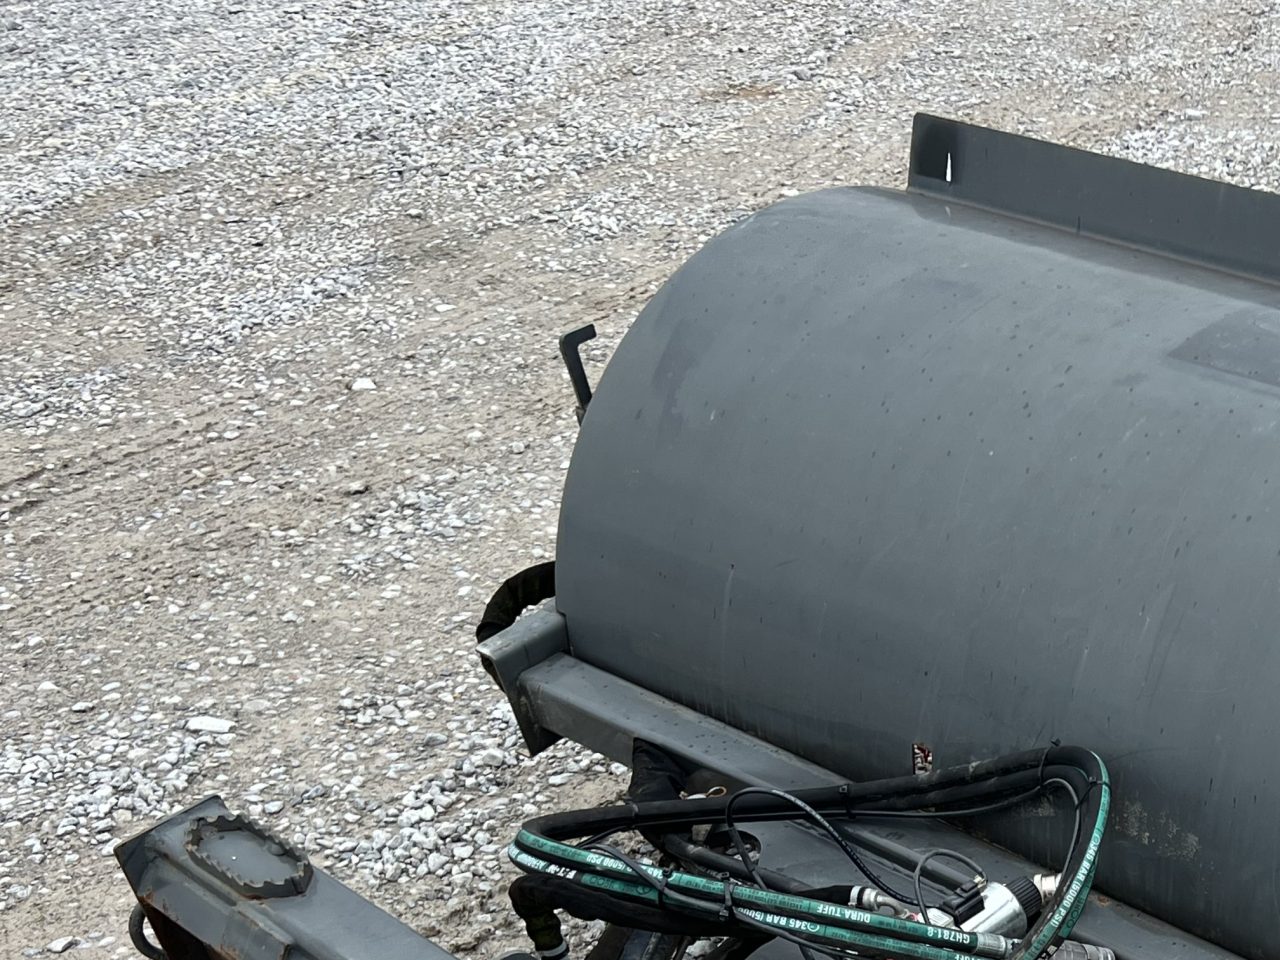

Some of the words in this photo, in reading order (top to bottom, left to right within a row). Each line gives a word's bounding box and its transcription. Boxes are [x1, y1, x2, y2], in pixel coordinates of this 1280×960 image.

[1076, 860, 1091, 882] BAR
[1063, 881, 1082, 907] (5000
[766, 911, 787, 926] BAR
[816, 903, 871, 923] DURA-TUFF
[789, 918, 808, 931] 345
[927, 926, 971, 945] GH781-8
